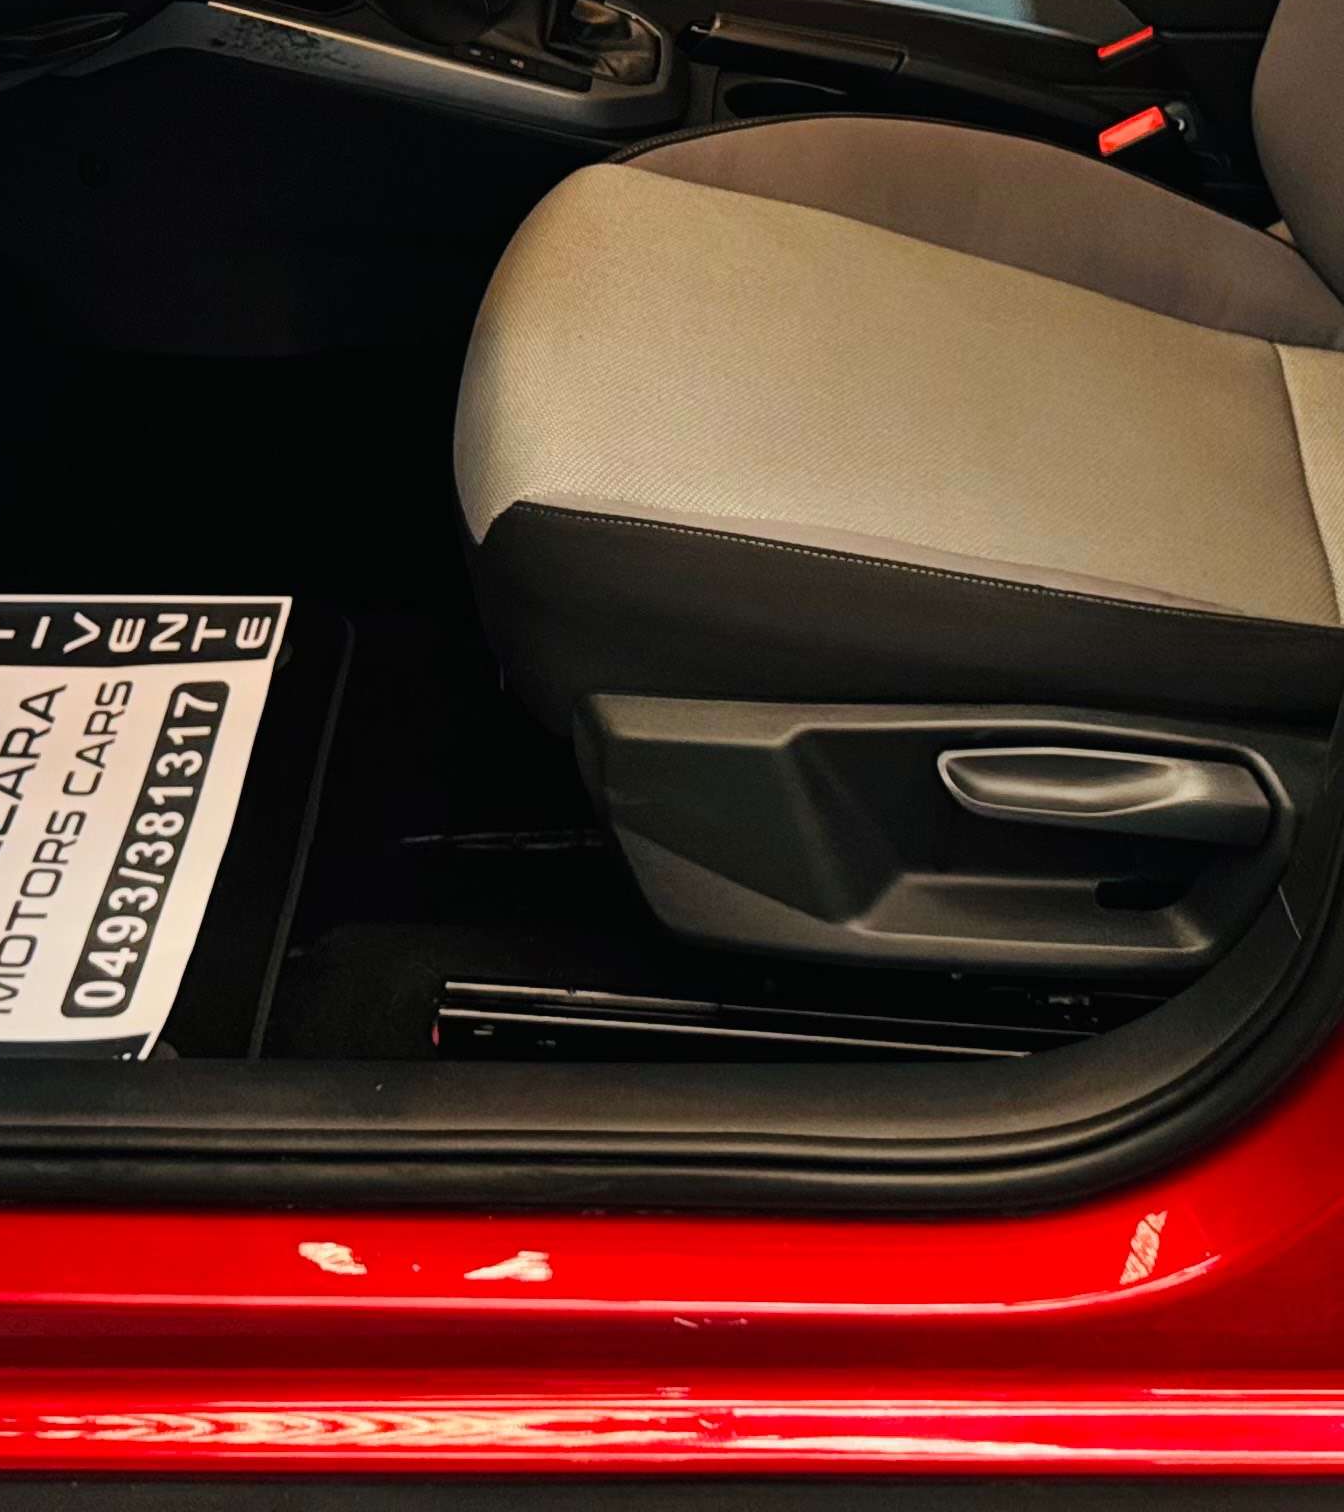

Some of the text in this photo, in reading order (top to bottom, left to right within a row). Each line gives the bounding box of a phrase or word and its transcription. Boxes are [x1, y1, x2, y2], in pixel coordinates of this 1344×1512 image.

[62, 611, 273, 653] VENTE
[61, 680, 133, 797] CARS
[73, 694, 222, 1009] 0493/381317
